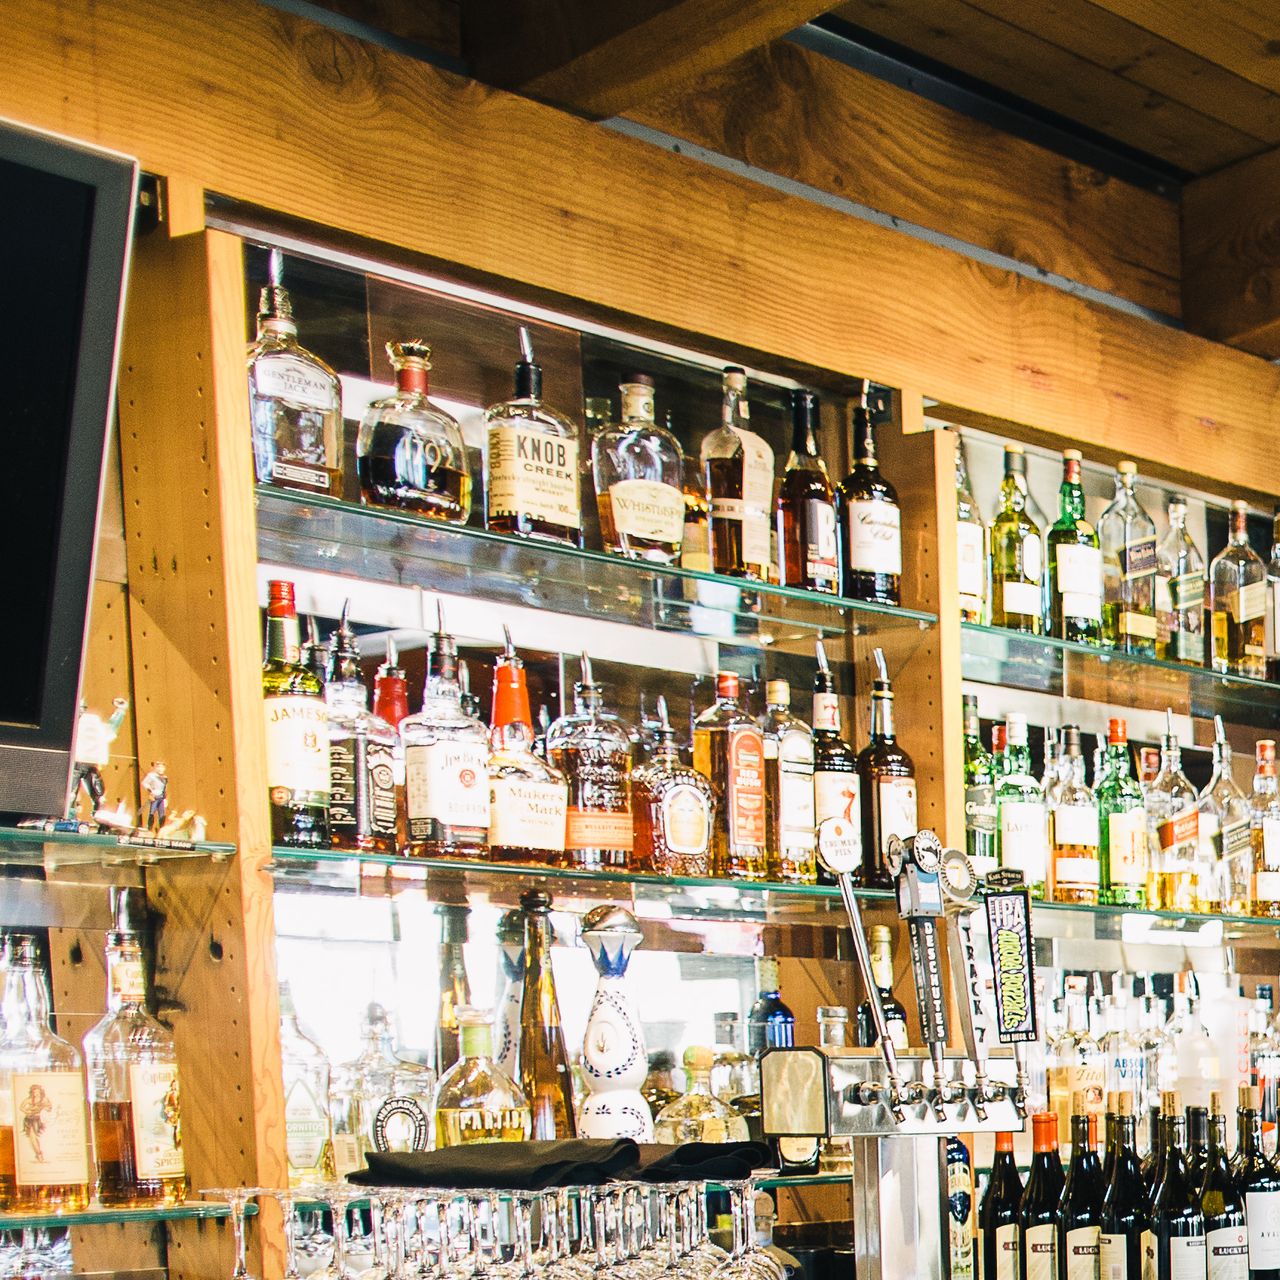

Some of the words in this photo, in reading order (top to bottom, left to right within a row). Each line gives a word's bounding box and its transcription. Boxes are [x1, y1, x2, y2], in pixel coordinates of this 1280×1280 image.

[263, 367, 327, 391] GENTLEMAN
[283, 381, 309, 394] JACK
[516, 434, 567, 468] KNOB
[523, 463, 574, 482] CREEK
[527, 802, 562, 817] Mark
[994, 899, 1025, 931] IPA
[923, 921, 946, 1038] DESCHUTES
[962, 926, 984, 1016] TRACK
[974, 1027, 986, 1043] 7
[1219, 1247, 1242, 1255] LUCKY
